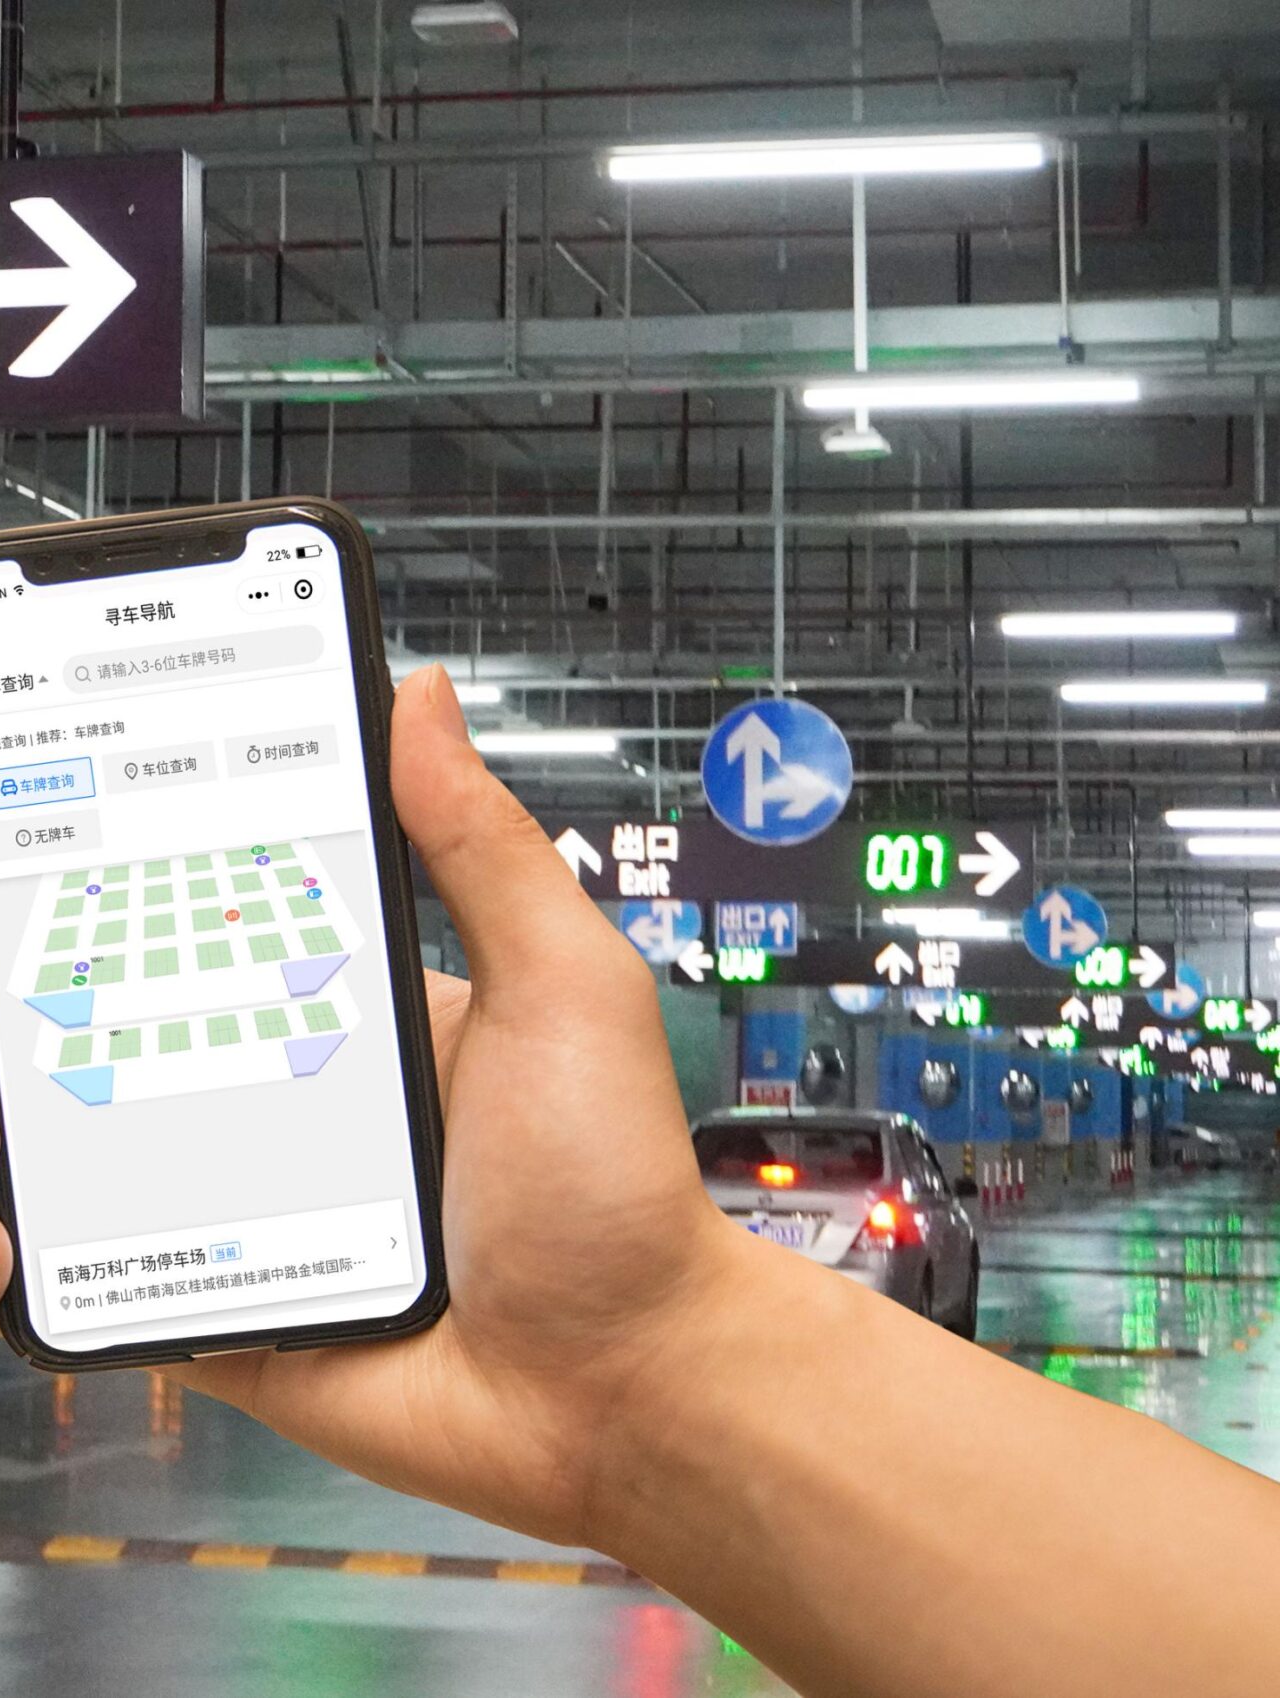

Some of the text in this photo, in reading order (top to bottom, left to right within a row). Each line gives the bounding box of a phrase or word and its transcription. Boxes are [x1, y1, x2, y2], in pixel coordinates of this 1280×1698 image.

[267, 549, 291, 562] 22%
[105, 600, 176, 627] 寻车导航
[97, 648, 236, 681] 请输入3-6位车牌号码
[264, 740, 319, 761] 时间查询
[142, 757, 197, 778] 车位查询
[20, 773, 74, 794] 车牌查询
[34, 825, 76, 846] 无牌车
[613, 822, 678, 861] 出口
[866, 834, 943, 892] 007
[619, 862, 670, 896] Exit
[721, 903, 766, 932] 出口
[215, 1246, 237, 1261] 当前
[57, 1247, 207, 1285] 南海万科广场停车场
[75, 1296, 95, 1309] 0m
